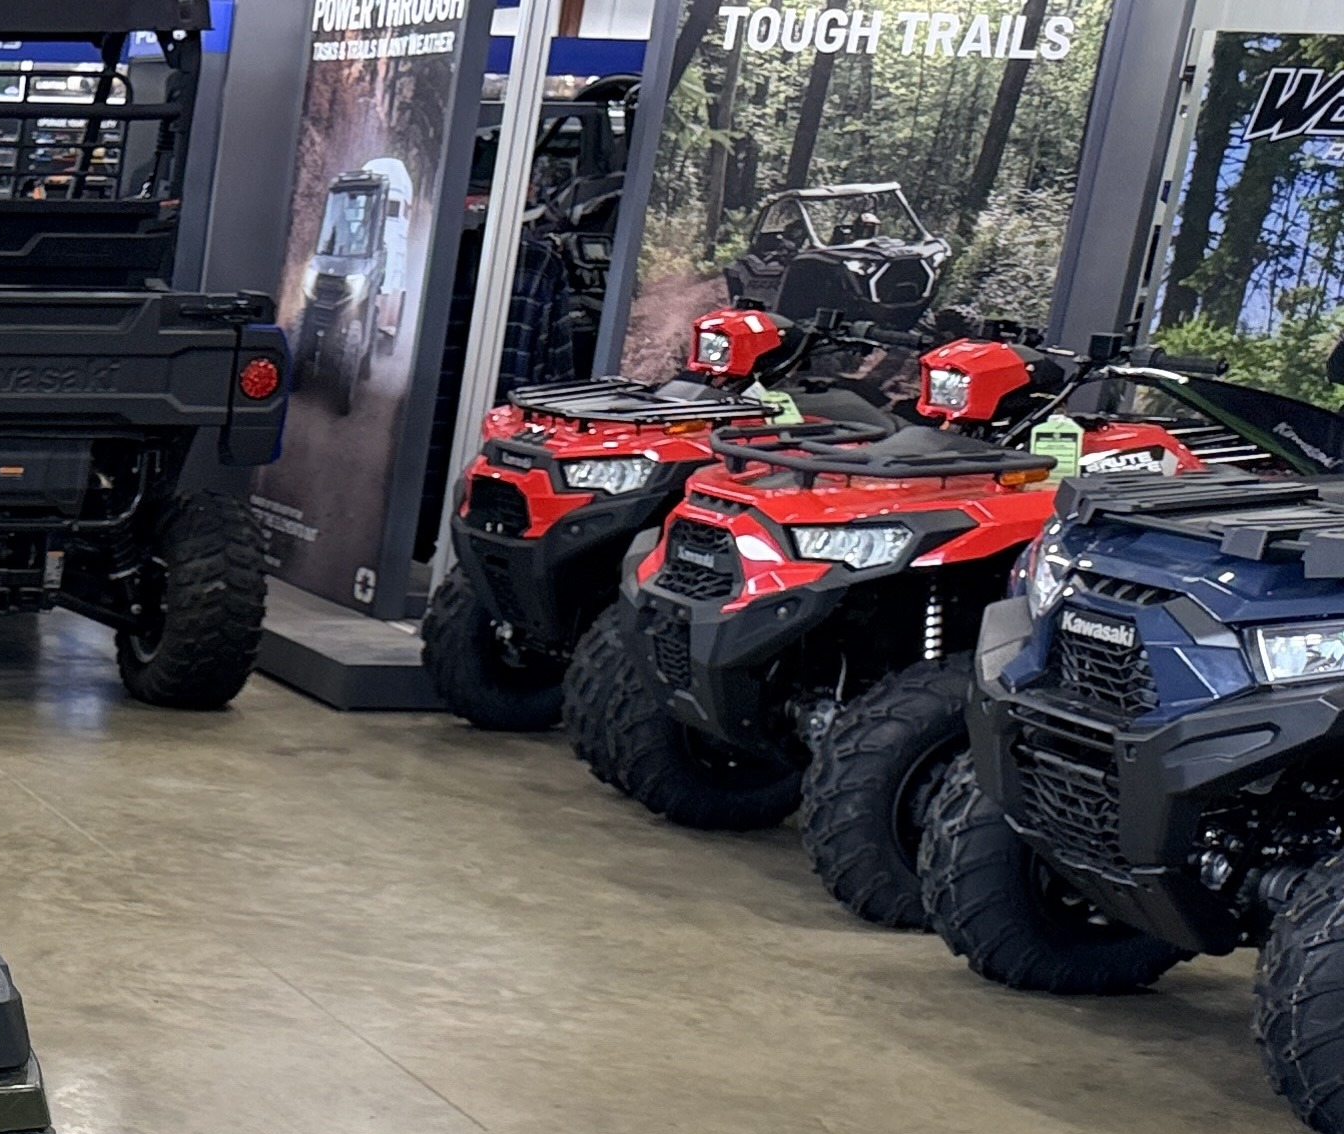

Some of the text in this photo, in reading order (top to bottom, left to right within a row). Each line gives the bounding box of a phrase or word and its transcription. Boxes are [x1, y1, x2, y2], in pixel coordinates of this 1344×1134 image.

[312, 0, 463, 32] POWER THROUGH
[718, 5, 1075, 60] TOUGH TRAILS
[408, 31, 455, 56] WEATHER
[1061, 611, 1135, 647] Kawasaki
